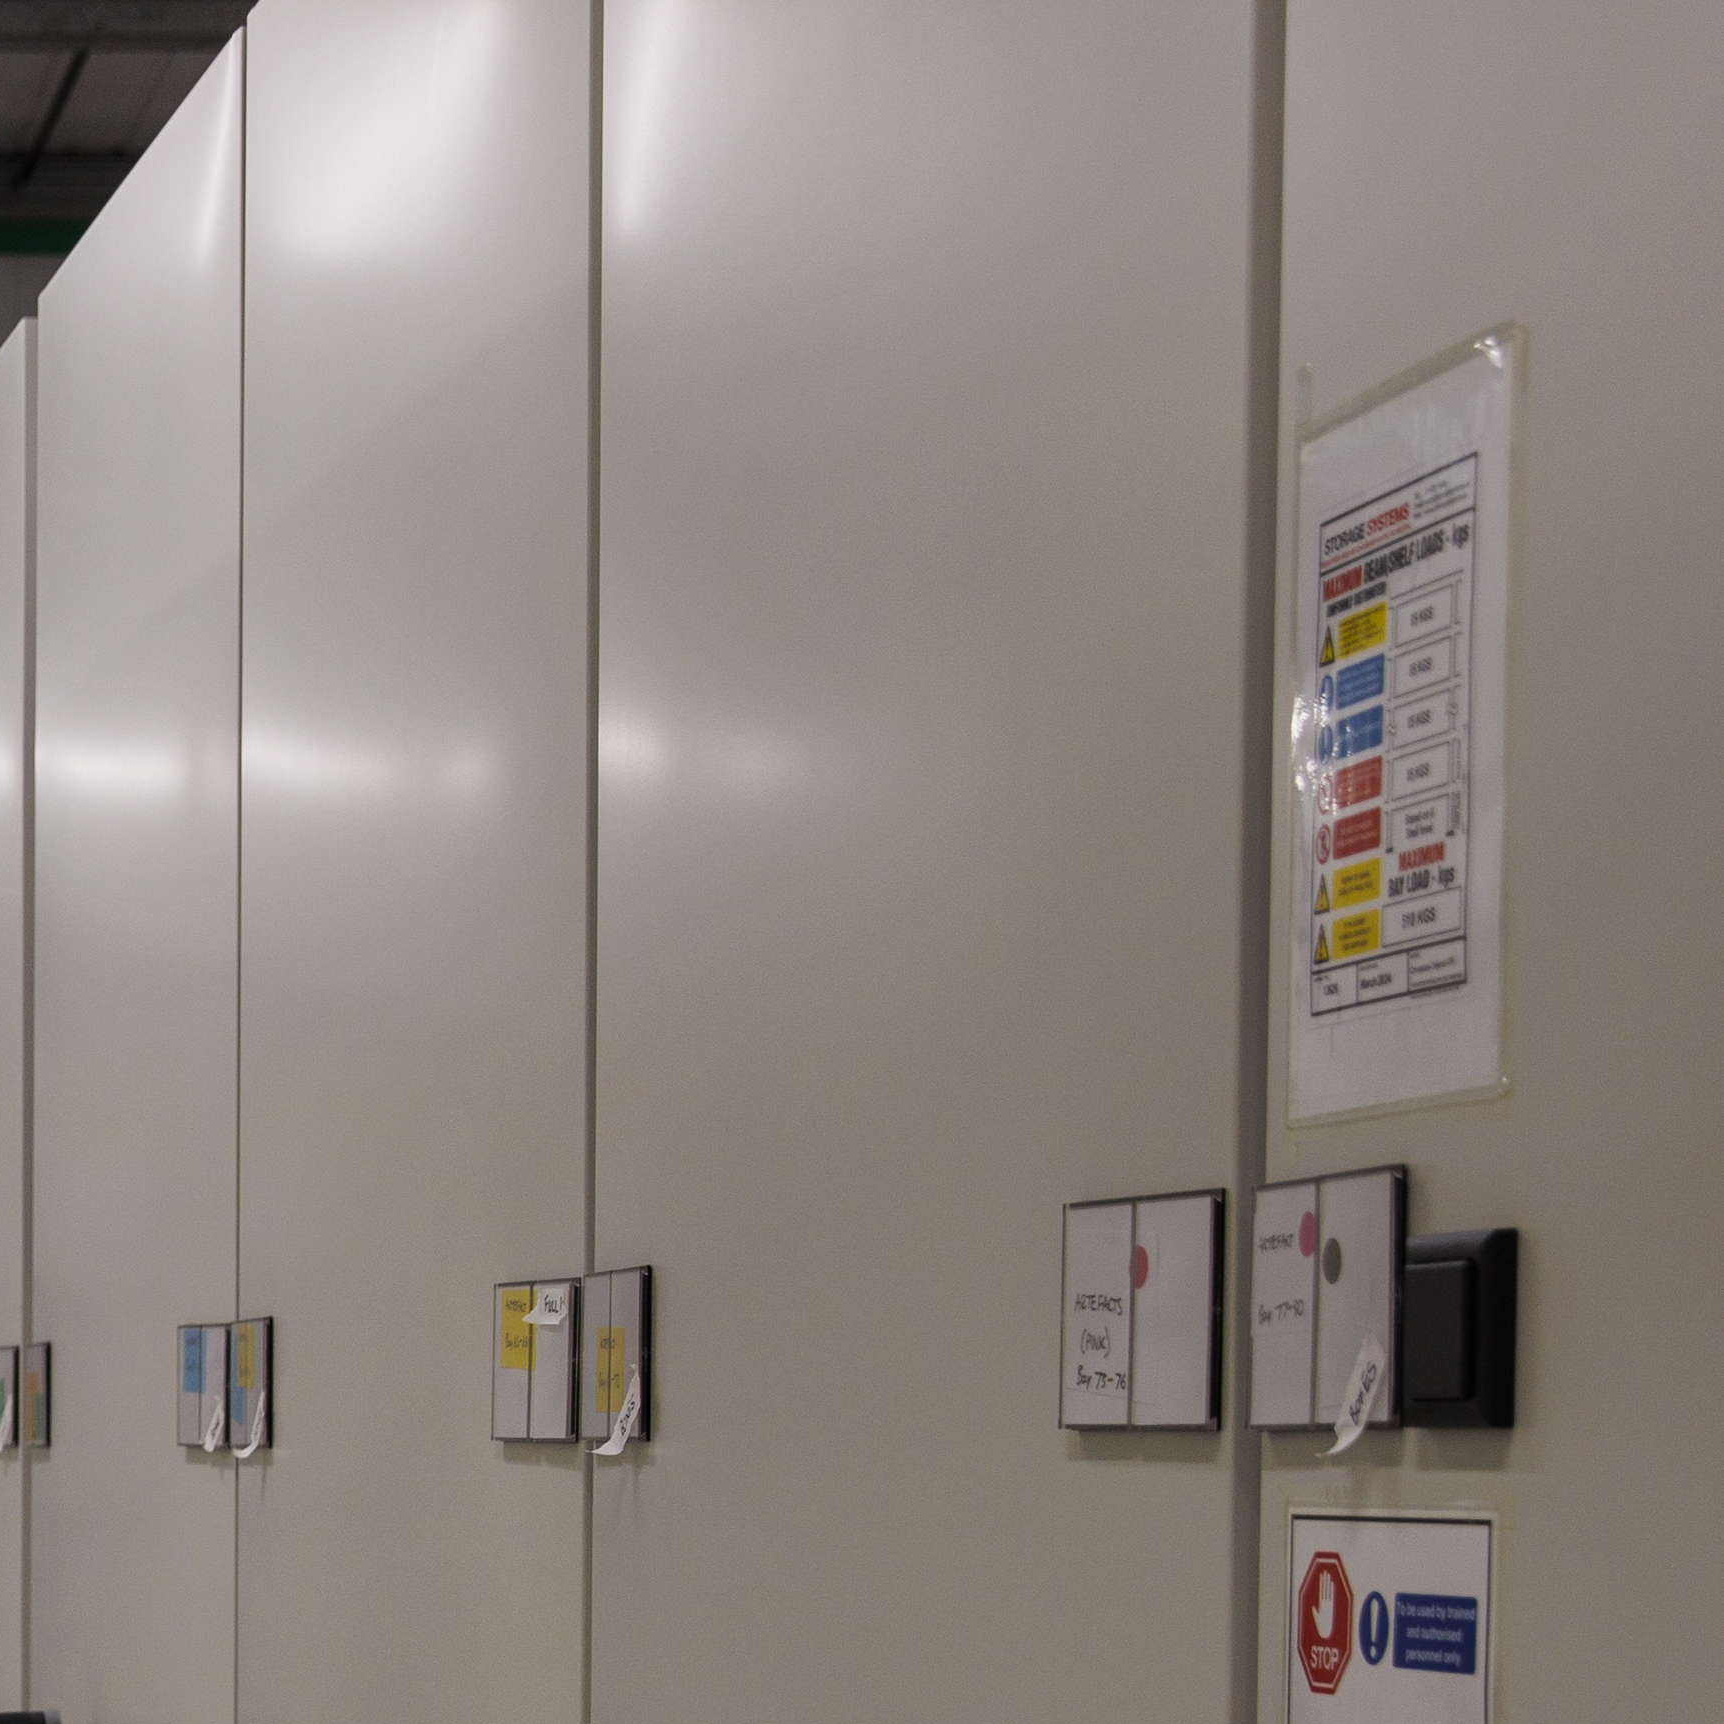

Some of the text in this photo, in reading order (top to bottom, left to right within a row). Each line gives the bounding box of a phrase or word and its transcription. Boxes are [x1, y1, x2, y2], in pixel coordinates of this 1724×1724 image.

[1076, 1364, 1092, 1390] Bay
[1396, 1601, 1474, 1622] To be used by trained
[1310, 1645, 1339, 1670] STOP
